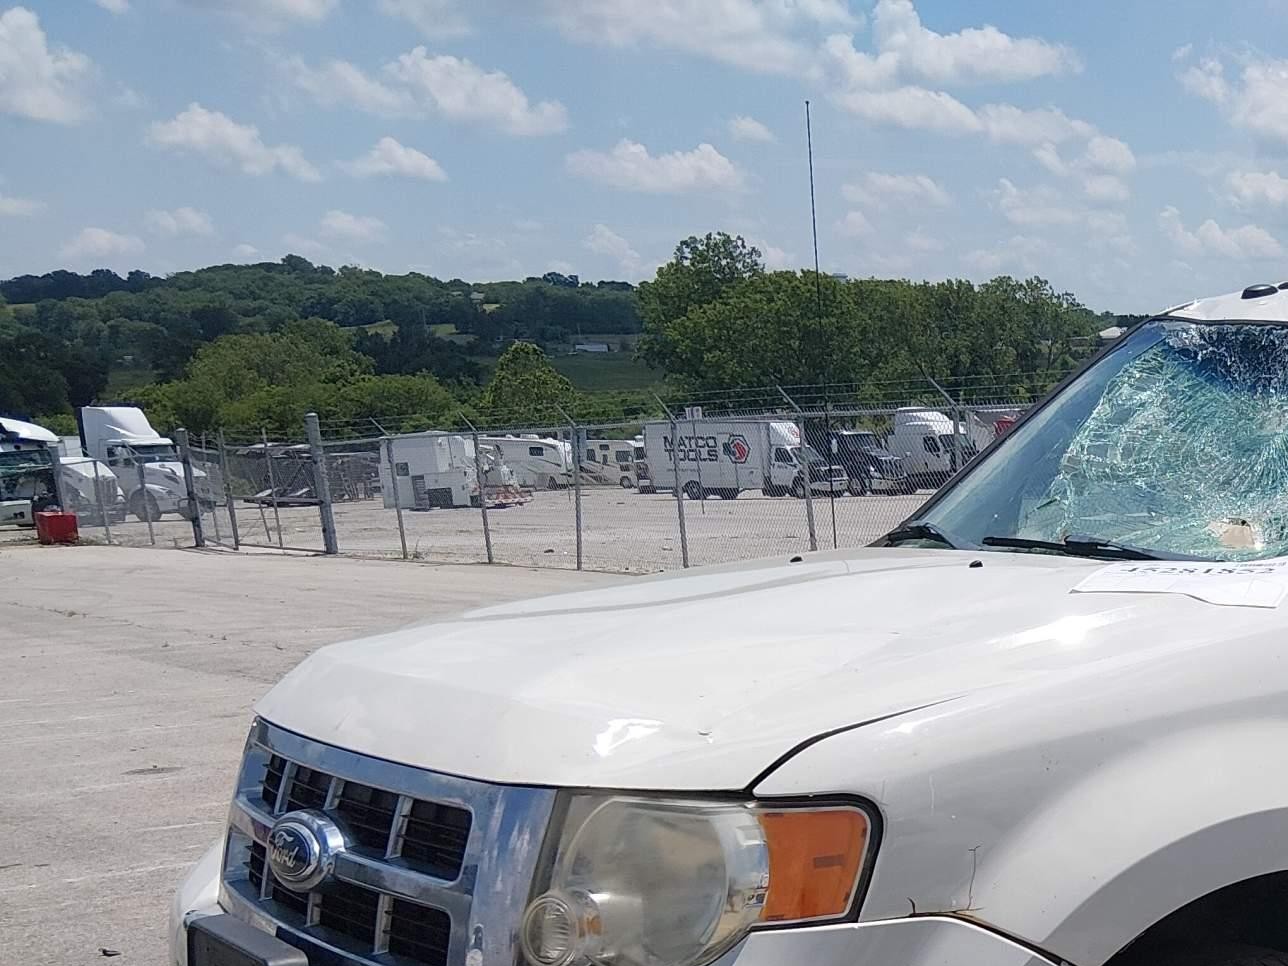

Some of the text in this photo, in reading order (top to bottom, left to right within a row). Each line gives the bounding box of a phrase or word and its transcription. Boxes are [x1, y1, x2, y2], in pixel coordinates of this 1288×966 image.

[663, 435, 718, 449] MATCO
[664, 448, 719, 462] TOOLS
[270, 831, 299, 868] Ford
